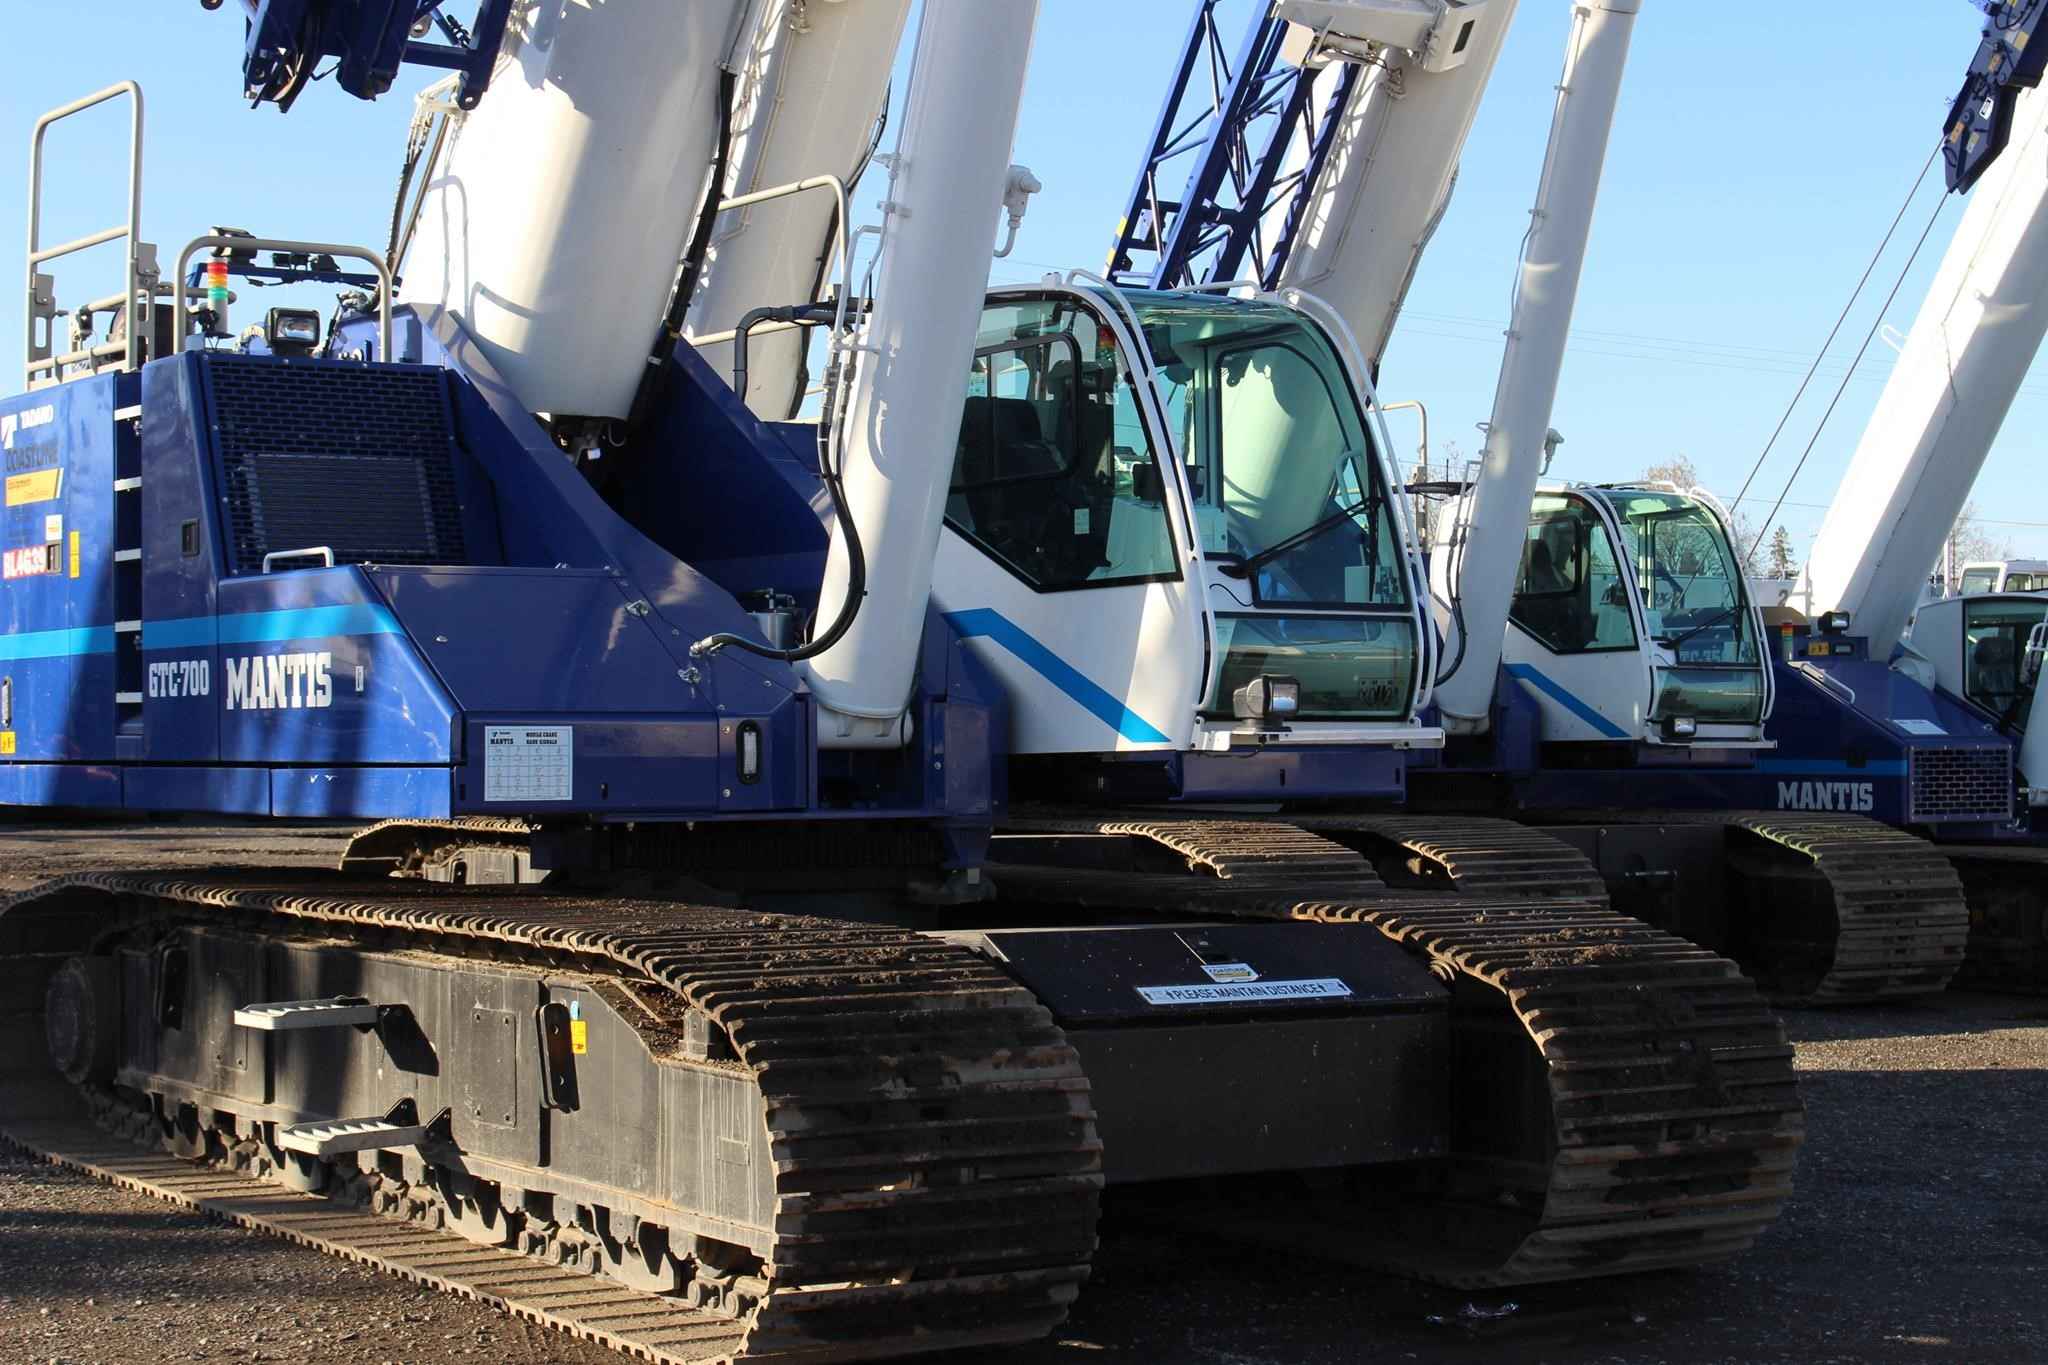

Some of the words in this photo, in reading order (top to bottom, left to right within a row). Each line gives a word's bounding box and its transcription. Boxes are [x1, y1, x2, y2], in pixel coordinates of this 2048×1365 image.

[149, 660, 210, 697] GTC-700
[225, 652, 333, 710] MANTIS
[1777, 781, 1873, 811] MANTIS
[1174, 988, 1216, 1000] PLEASE
[1215, 986, 1267, 999] MAINTAIN
[1266, 984, 1321, 996] DISTANCE
